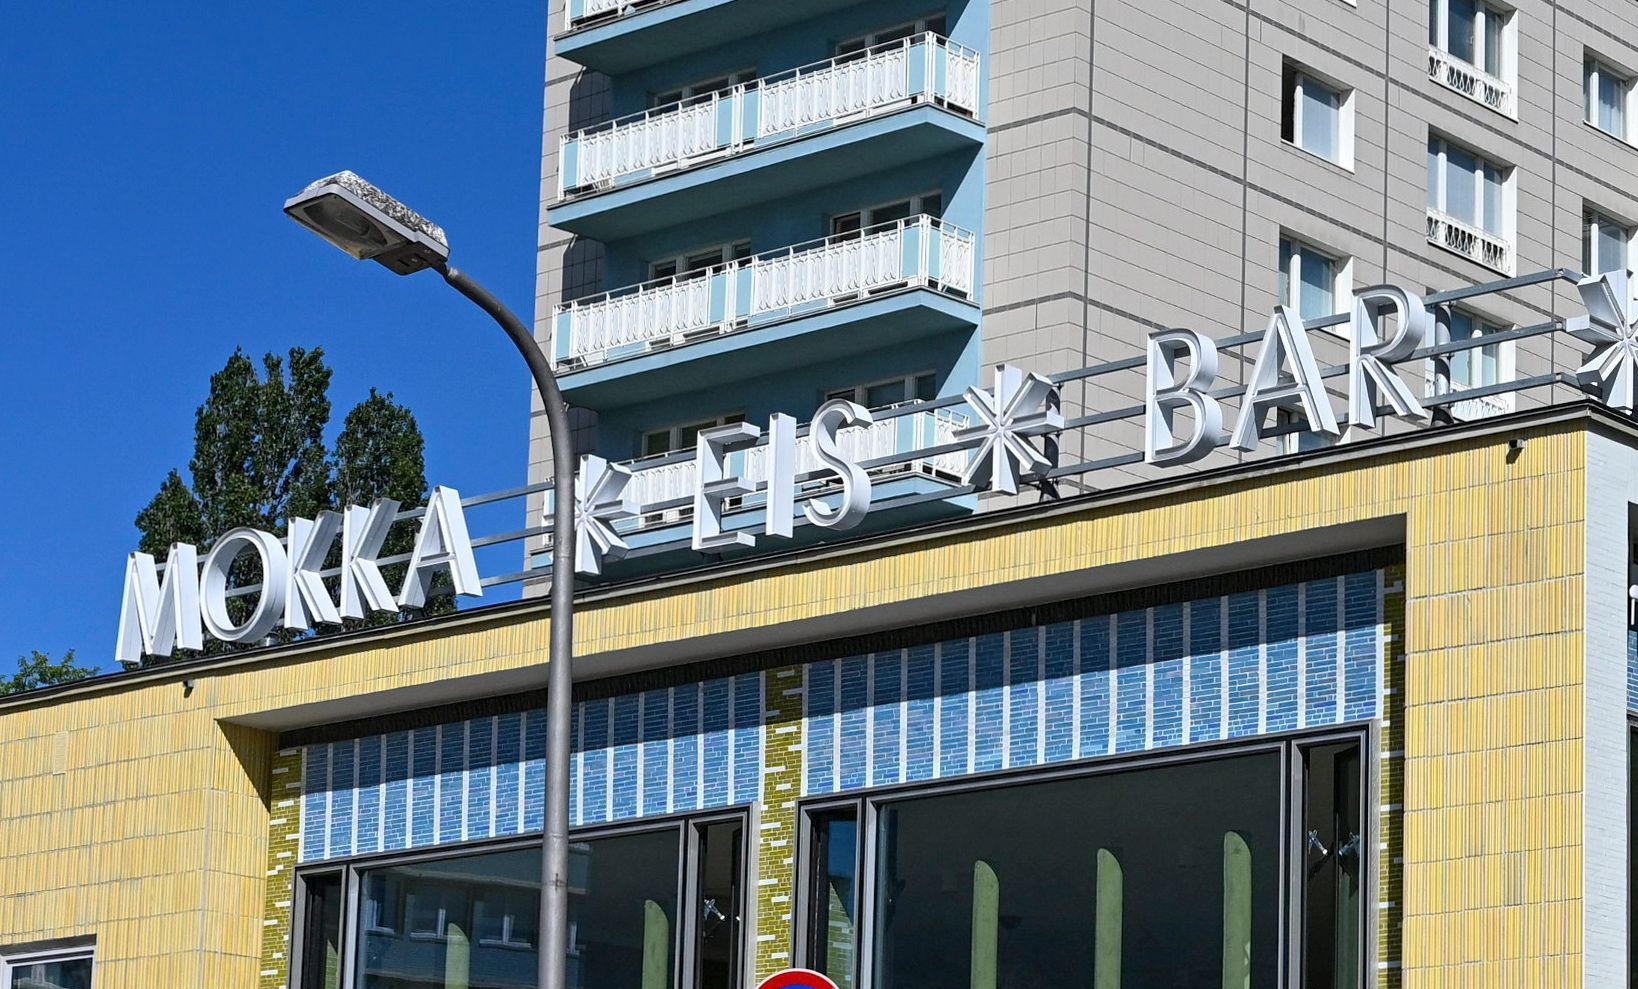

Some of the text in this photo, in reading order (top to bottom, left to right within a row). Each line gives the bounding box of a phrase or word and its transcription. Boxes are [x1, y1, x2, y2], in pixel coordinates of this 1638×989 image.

[114, 283, 1428, 663] MOKKA EIS BAR
